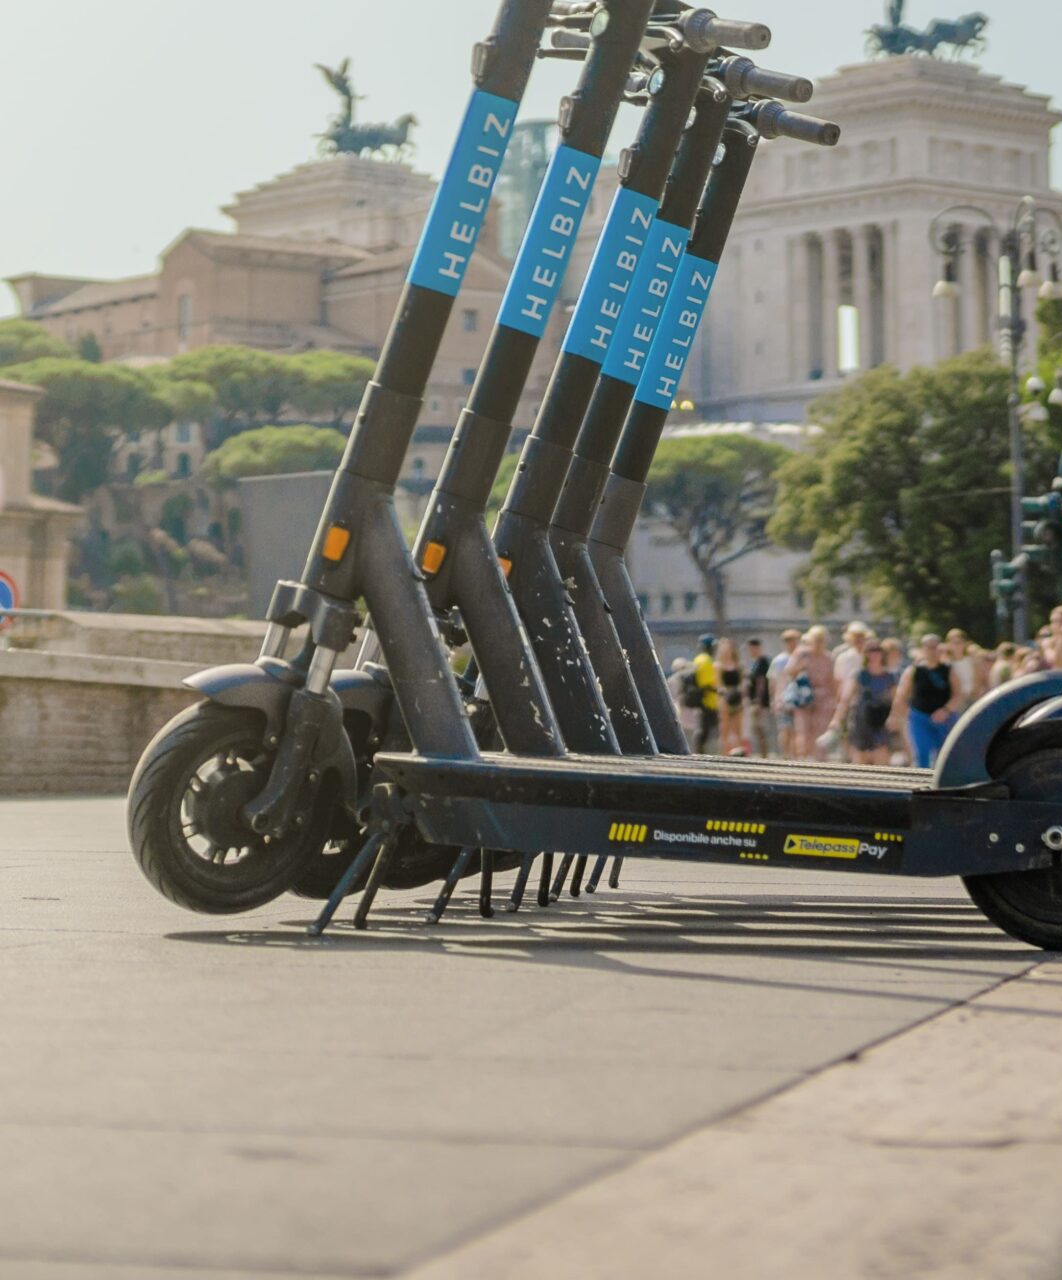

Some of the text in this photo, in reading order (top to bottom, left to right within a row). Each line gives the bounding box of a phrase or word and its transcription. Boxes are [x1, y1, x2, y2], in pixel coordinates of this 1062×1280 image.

[439, 112, 512, 280] HELBIZ
[521, 166, 592, 322] HELBIZ
[590, 207, 653, 349] HELBIZ
[624, 236, 683, 371] HELBIZ
[656, 270, 712, 399] HELBIZ
[653, 829, 757, 848] Disponibile anche su
[798, 839, 888, 860] Telepass Pay
